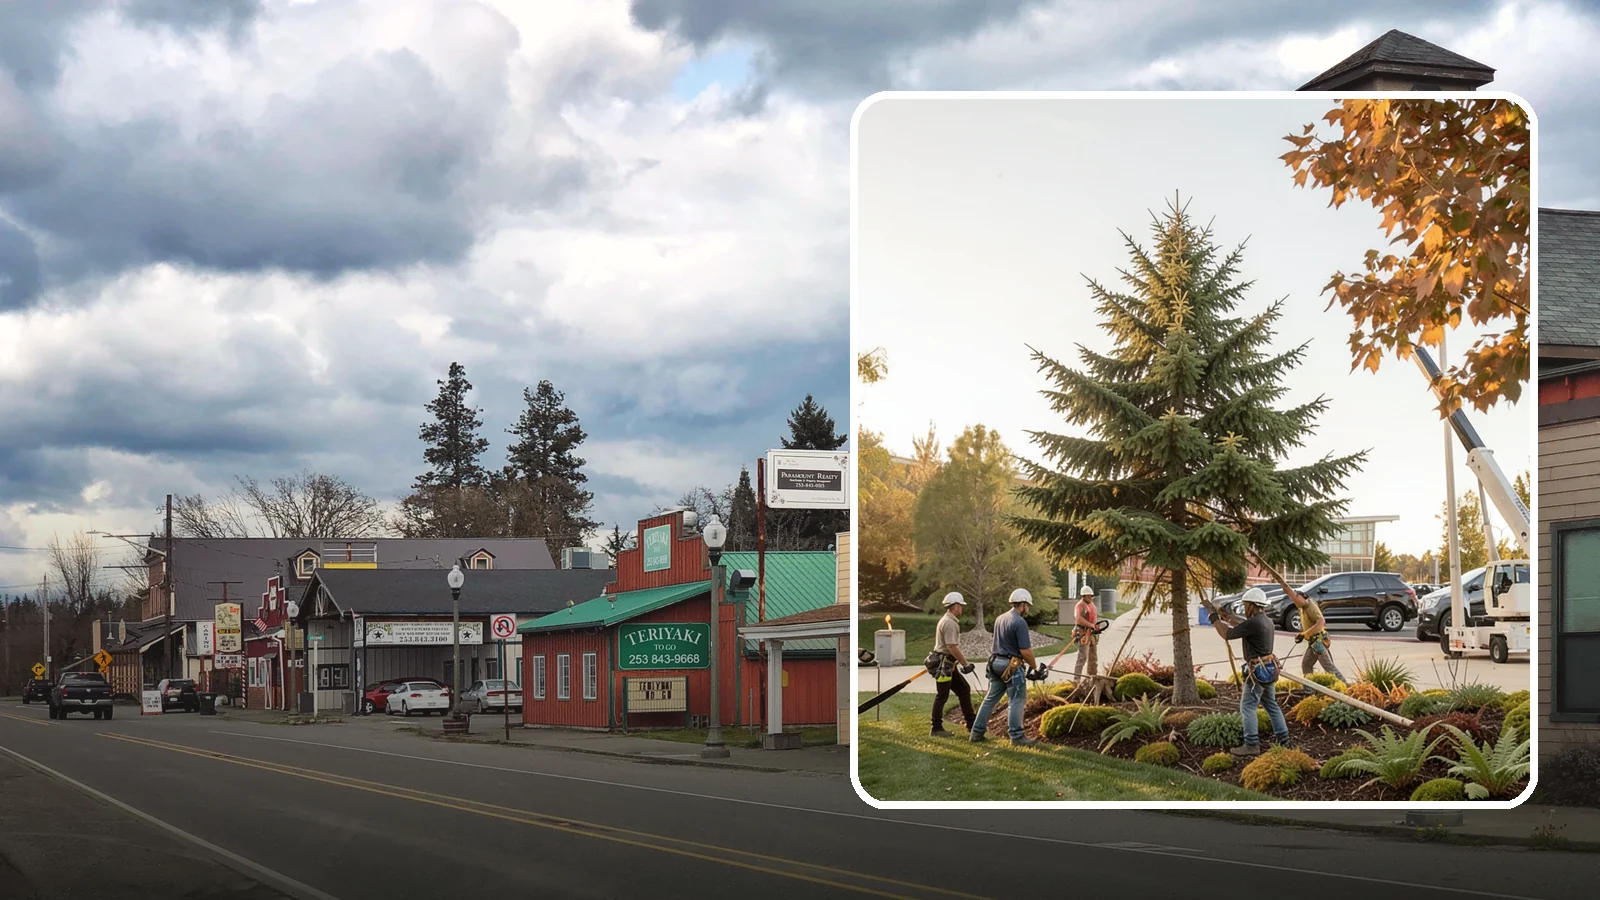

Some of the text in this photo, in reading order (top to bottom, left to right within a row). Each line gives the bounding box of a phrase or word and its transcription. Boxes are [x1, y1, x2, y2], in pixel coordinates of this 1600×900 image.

[625, 627, 702, 646] TERIYAKI
[629, 653, 700, 664] 253 843-9668
[639, 680, 672, 691] TERIYAKI
